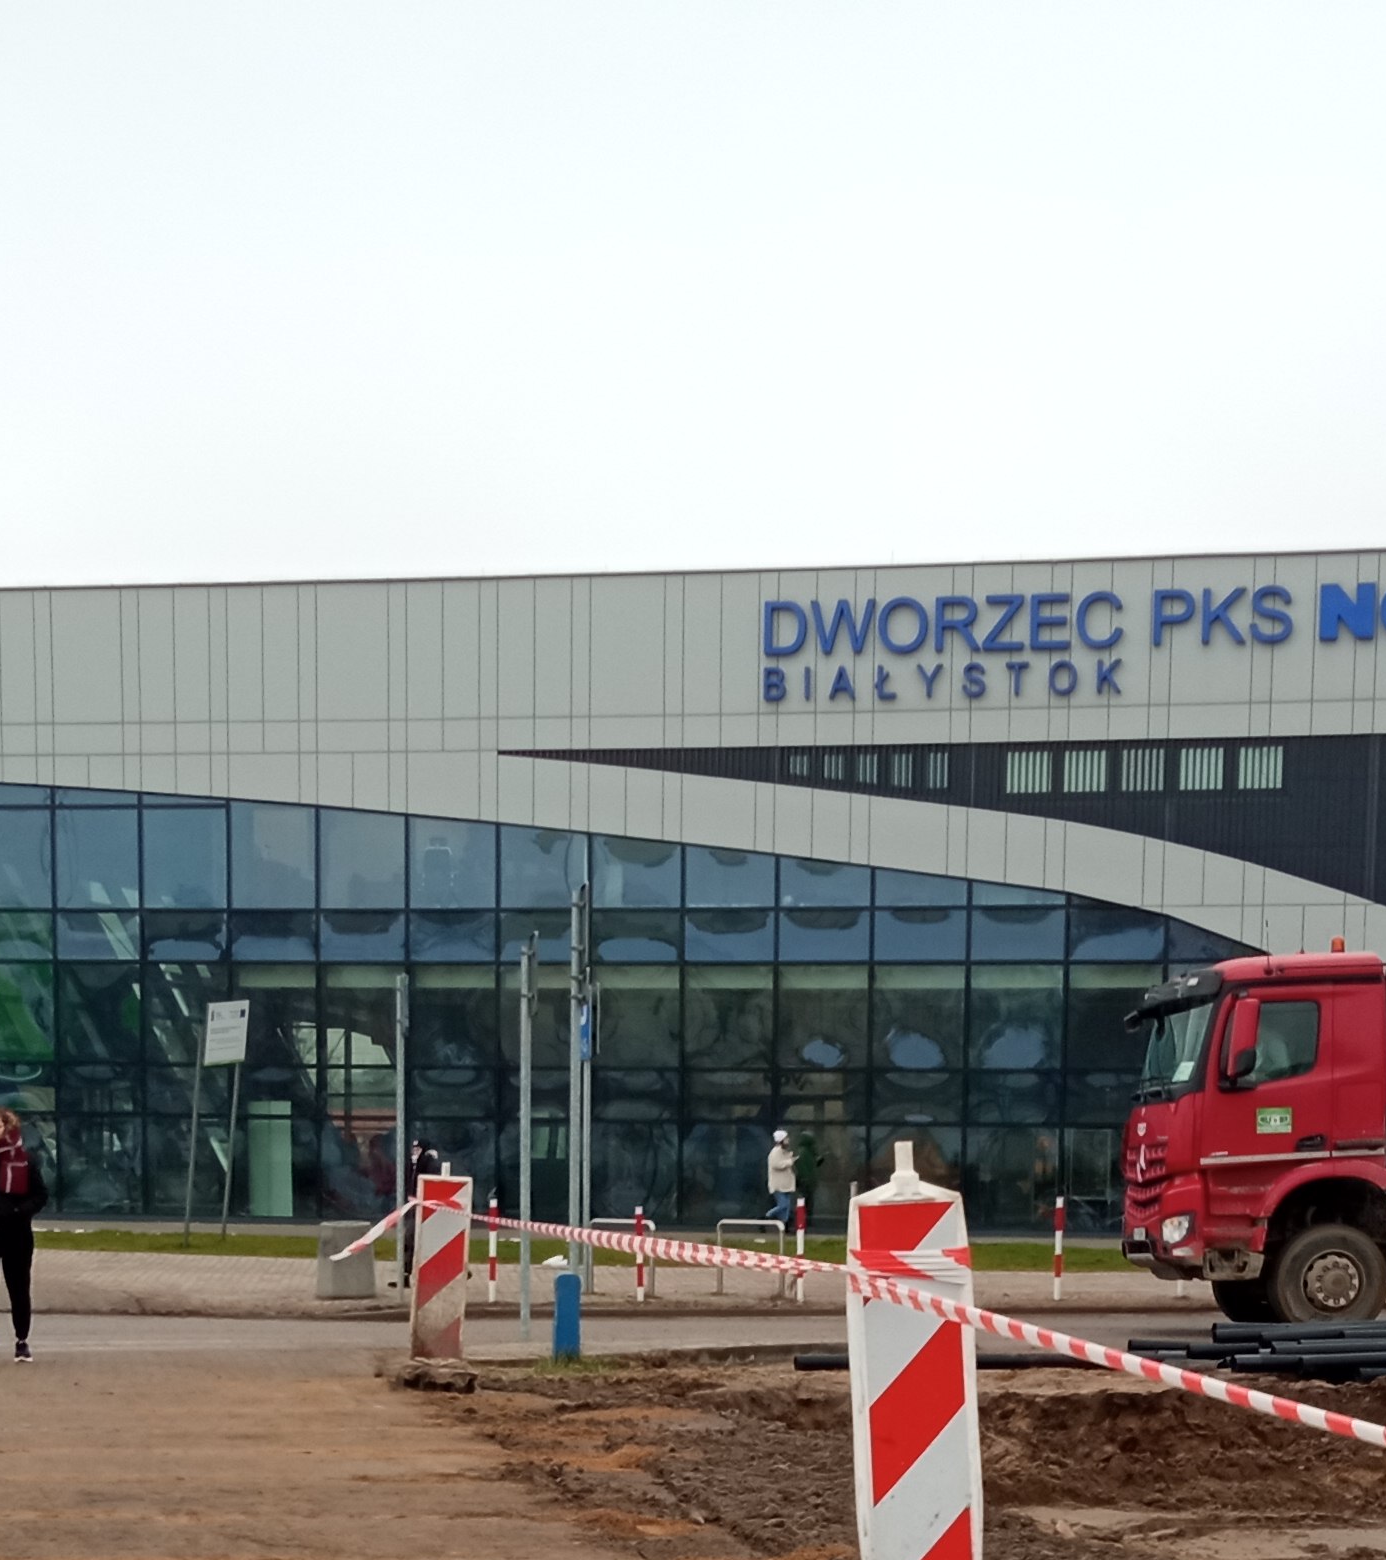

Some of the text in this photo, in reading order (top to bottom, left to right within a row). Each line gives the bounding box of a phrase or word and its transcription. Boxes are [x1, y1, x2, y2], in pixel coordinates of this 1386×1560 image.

[762, 590, 1124, 656] DWORZEC
[1151, 584, 1295, 648] PKS
[763, 658, 1123, 702] BIAŁYSTOK
